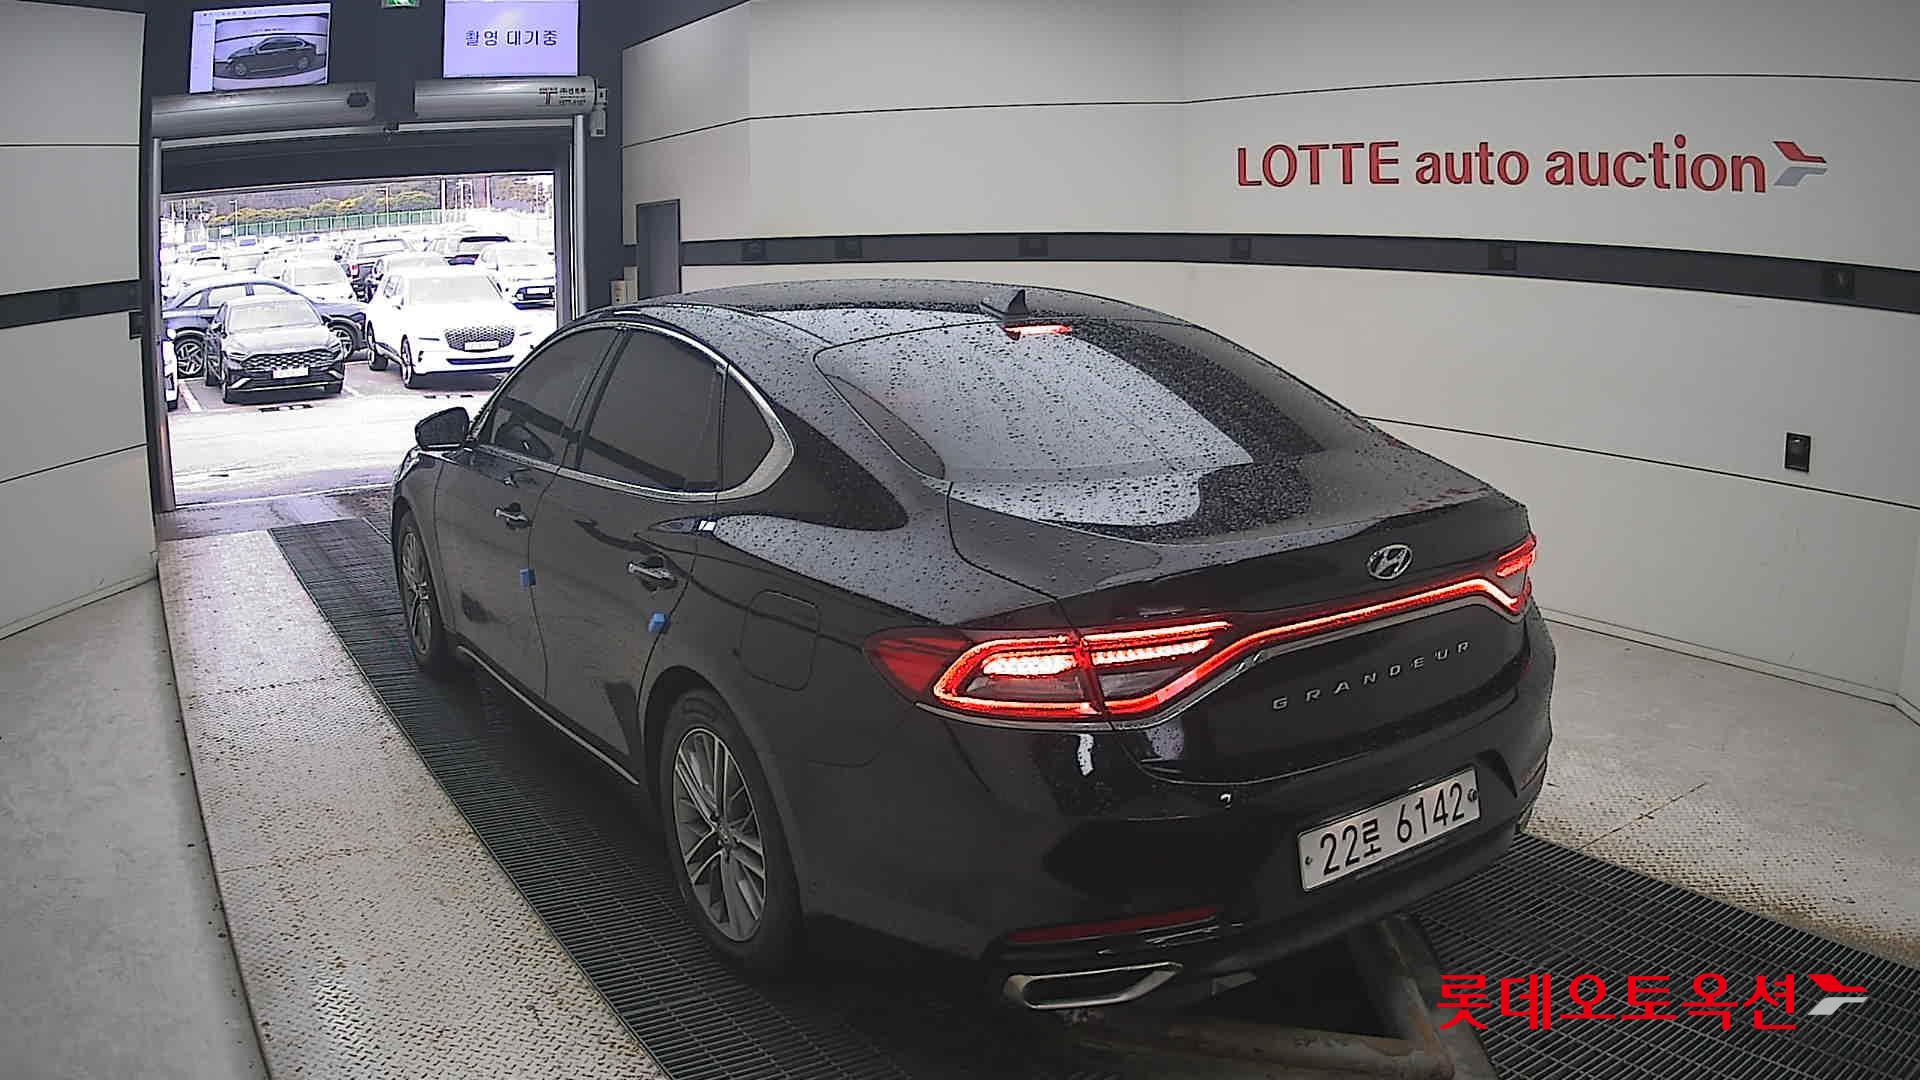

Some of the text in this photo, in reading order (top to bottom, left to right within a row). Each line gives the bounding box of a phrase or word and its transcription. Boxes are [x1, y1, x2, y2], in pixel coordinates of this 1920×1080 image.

[465, 30, 558, 47] 촬영 대기중
[1237, 134, 1767, 194] LOTTE auto auction
[1273, 641, 1470, 710] GRANDEUR
[1397, 782, 1465, 843] 6142
